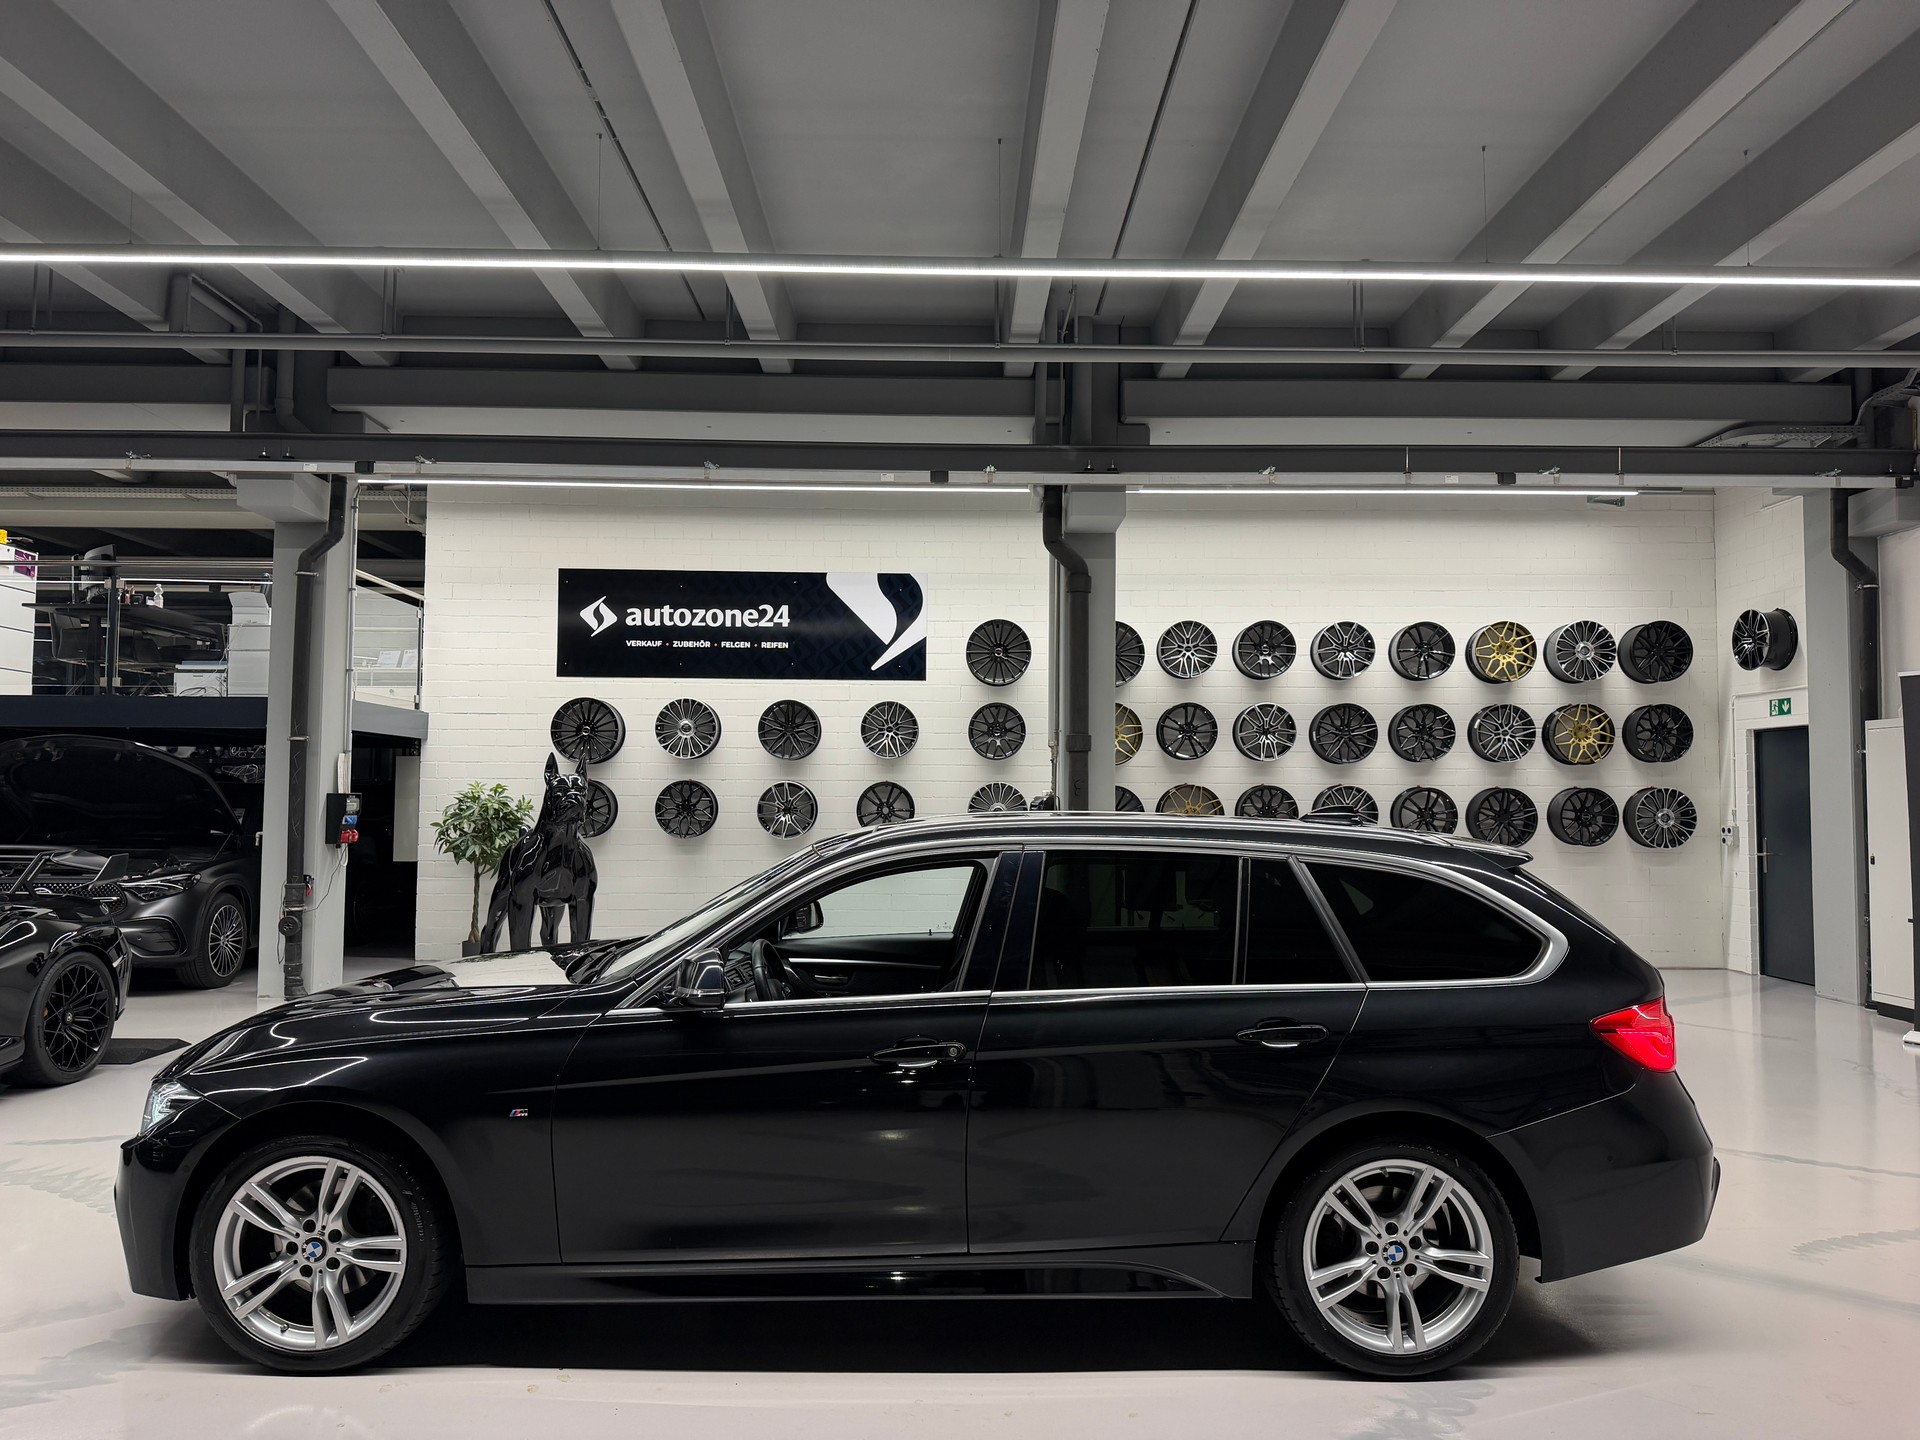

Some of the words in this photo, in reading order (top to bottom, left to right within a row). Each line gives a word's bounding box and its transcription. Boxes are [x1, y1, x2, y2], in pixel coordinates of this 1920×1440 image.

[625, 604, 791, 628] autozone24
[625, 639, 663, 648] VERKAUF
[672, 639, 711, 649] ZUBEHÖR
[720, 641, 751, 649] FELGEN
[760, 641, 789, 649] REIFEN
